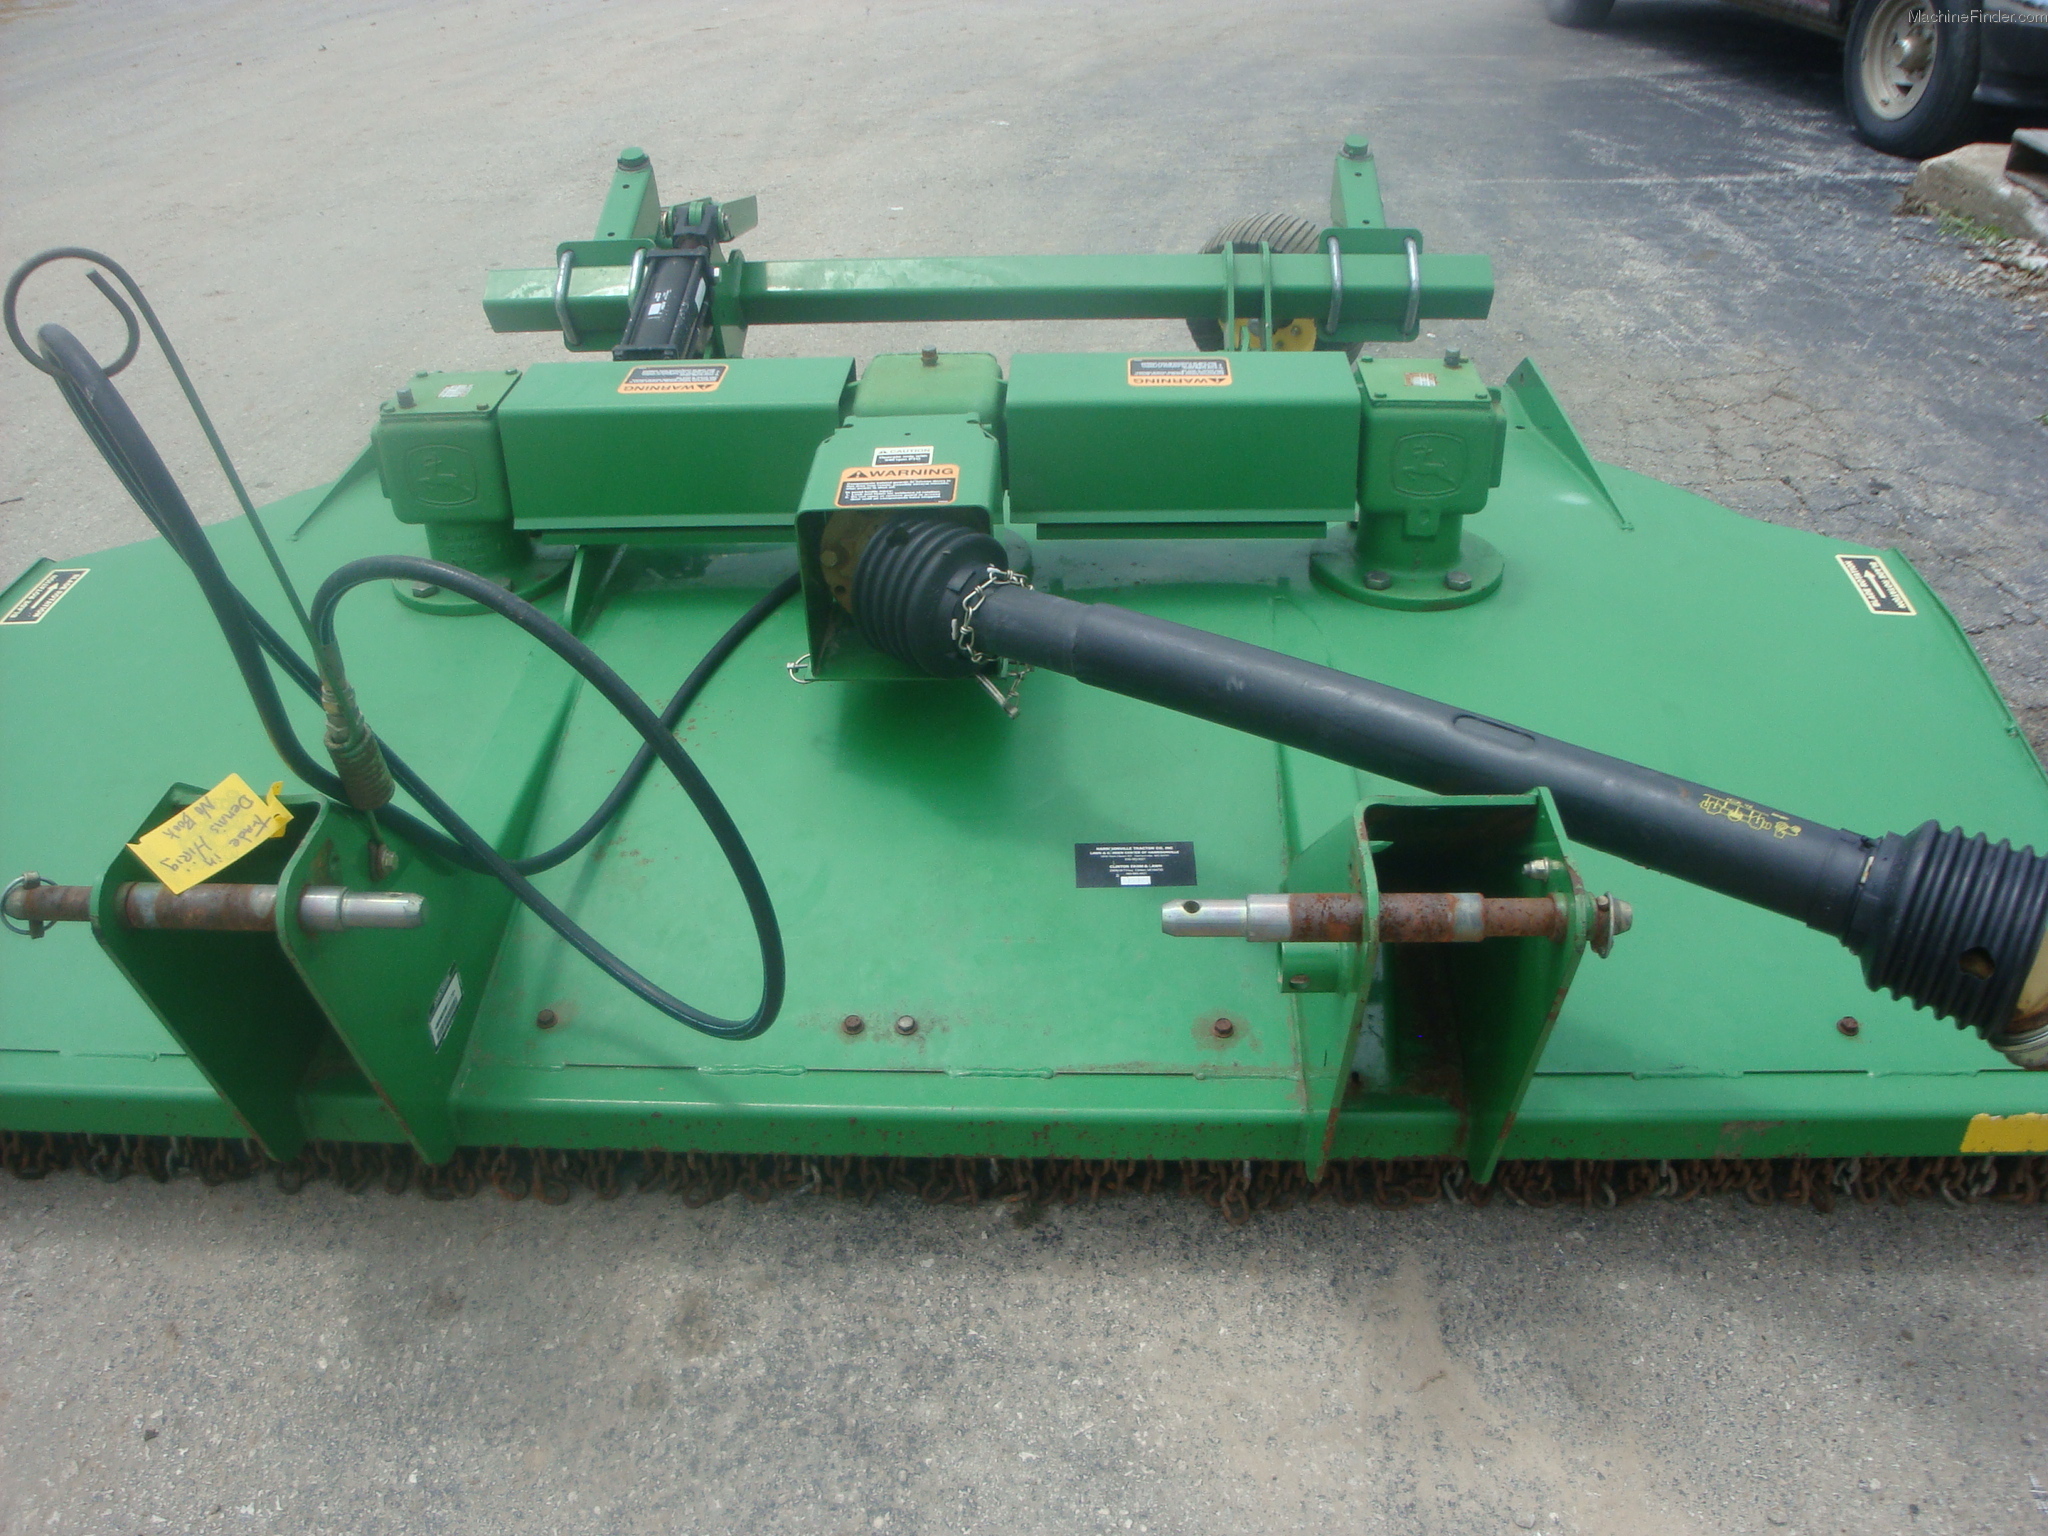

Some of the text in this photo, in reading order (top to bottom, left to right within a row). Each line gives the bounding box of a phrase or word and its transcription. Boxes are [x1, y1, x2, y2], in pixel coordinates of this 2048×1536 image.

[1133, 377, 1208, 385] WARNING
[624, 384, 695, 393] WARNING
[869, 467, 954, 478] WARNING
[209, 794, 254, 834] Dennis
[162, 811, 197, 840] Book
